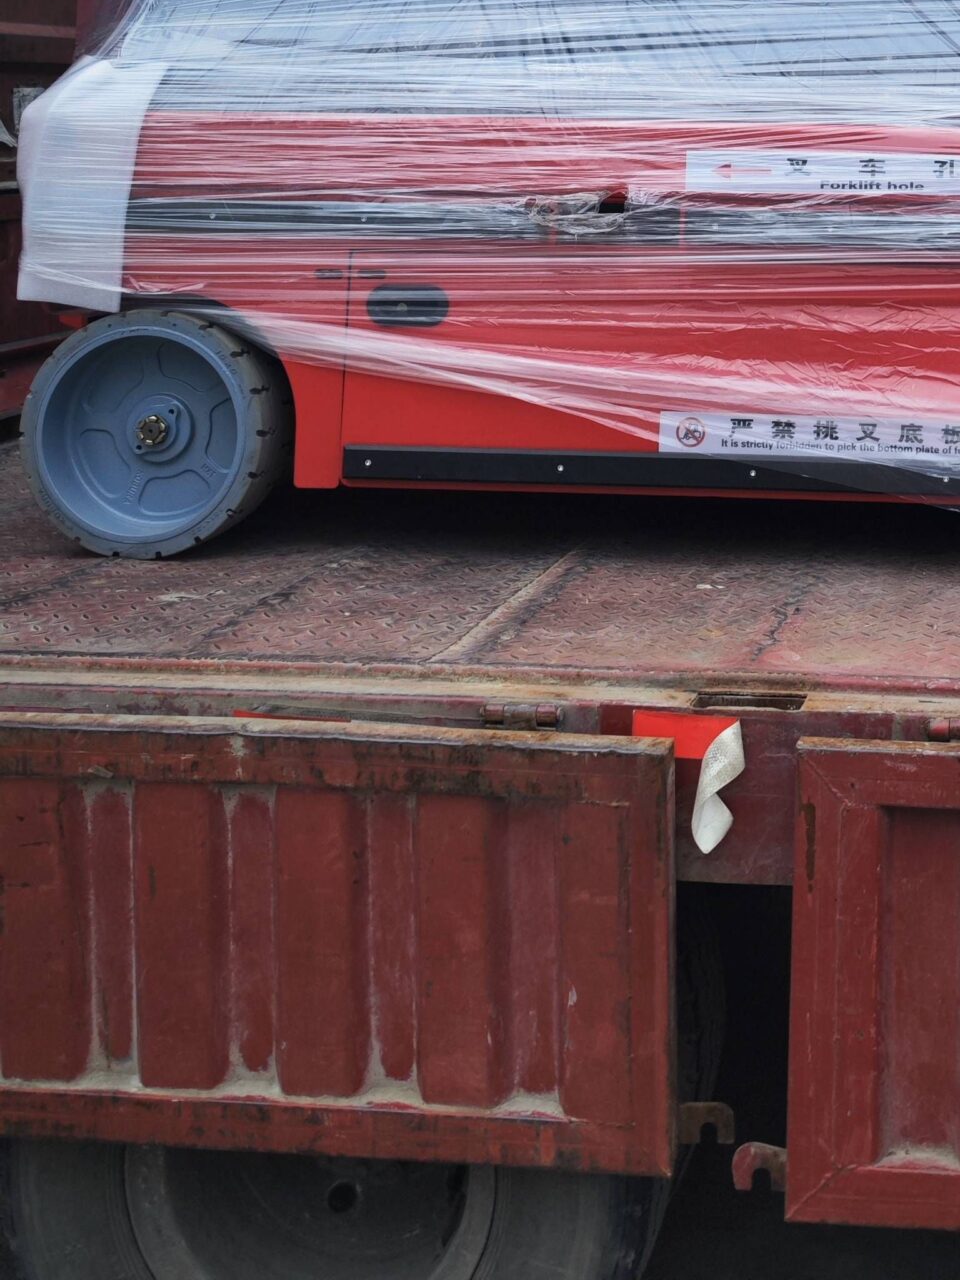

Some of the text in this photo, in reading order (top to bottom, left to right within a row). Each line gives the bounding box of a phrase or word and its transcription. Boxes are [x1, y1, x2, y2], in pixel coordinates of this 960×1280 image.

[820, 180, 925, 191] Forklift hole
[721, 438, 728, 448] It
[730, 438, 739, 448] is
[825, 442, 834, 451] to
[837, 443, 857, 453] pick
[860, 443, 875, 452] the
[877, 443, 913, 453] bottom
[916, 445, 940, 455] plate
[942, 445, 951, 455] of
